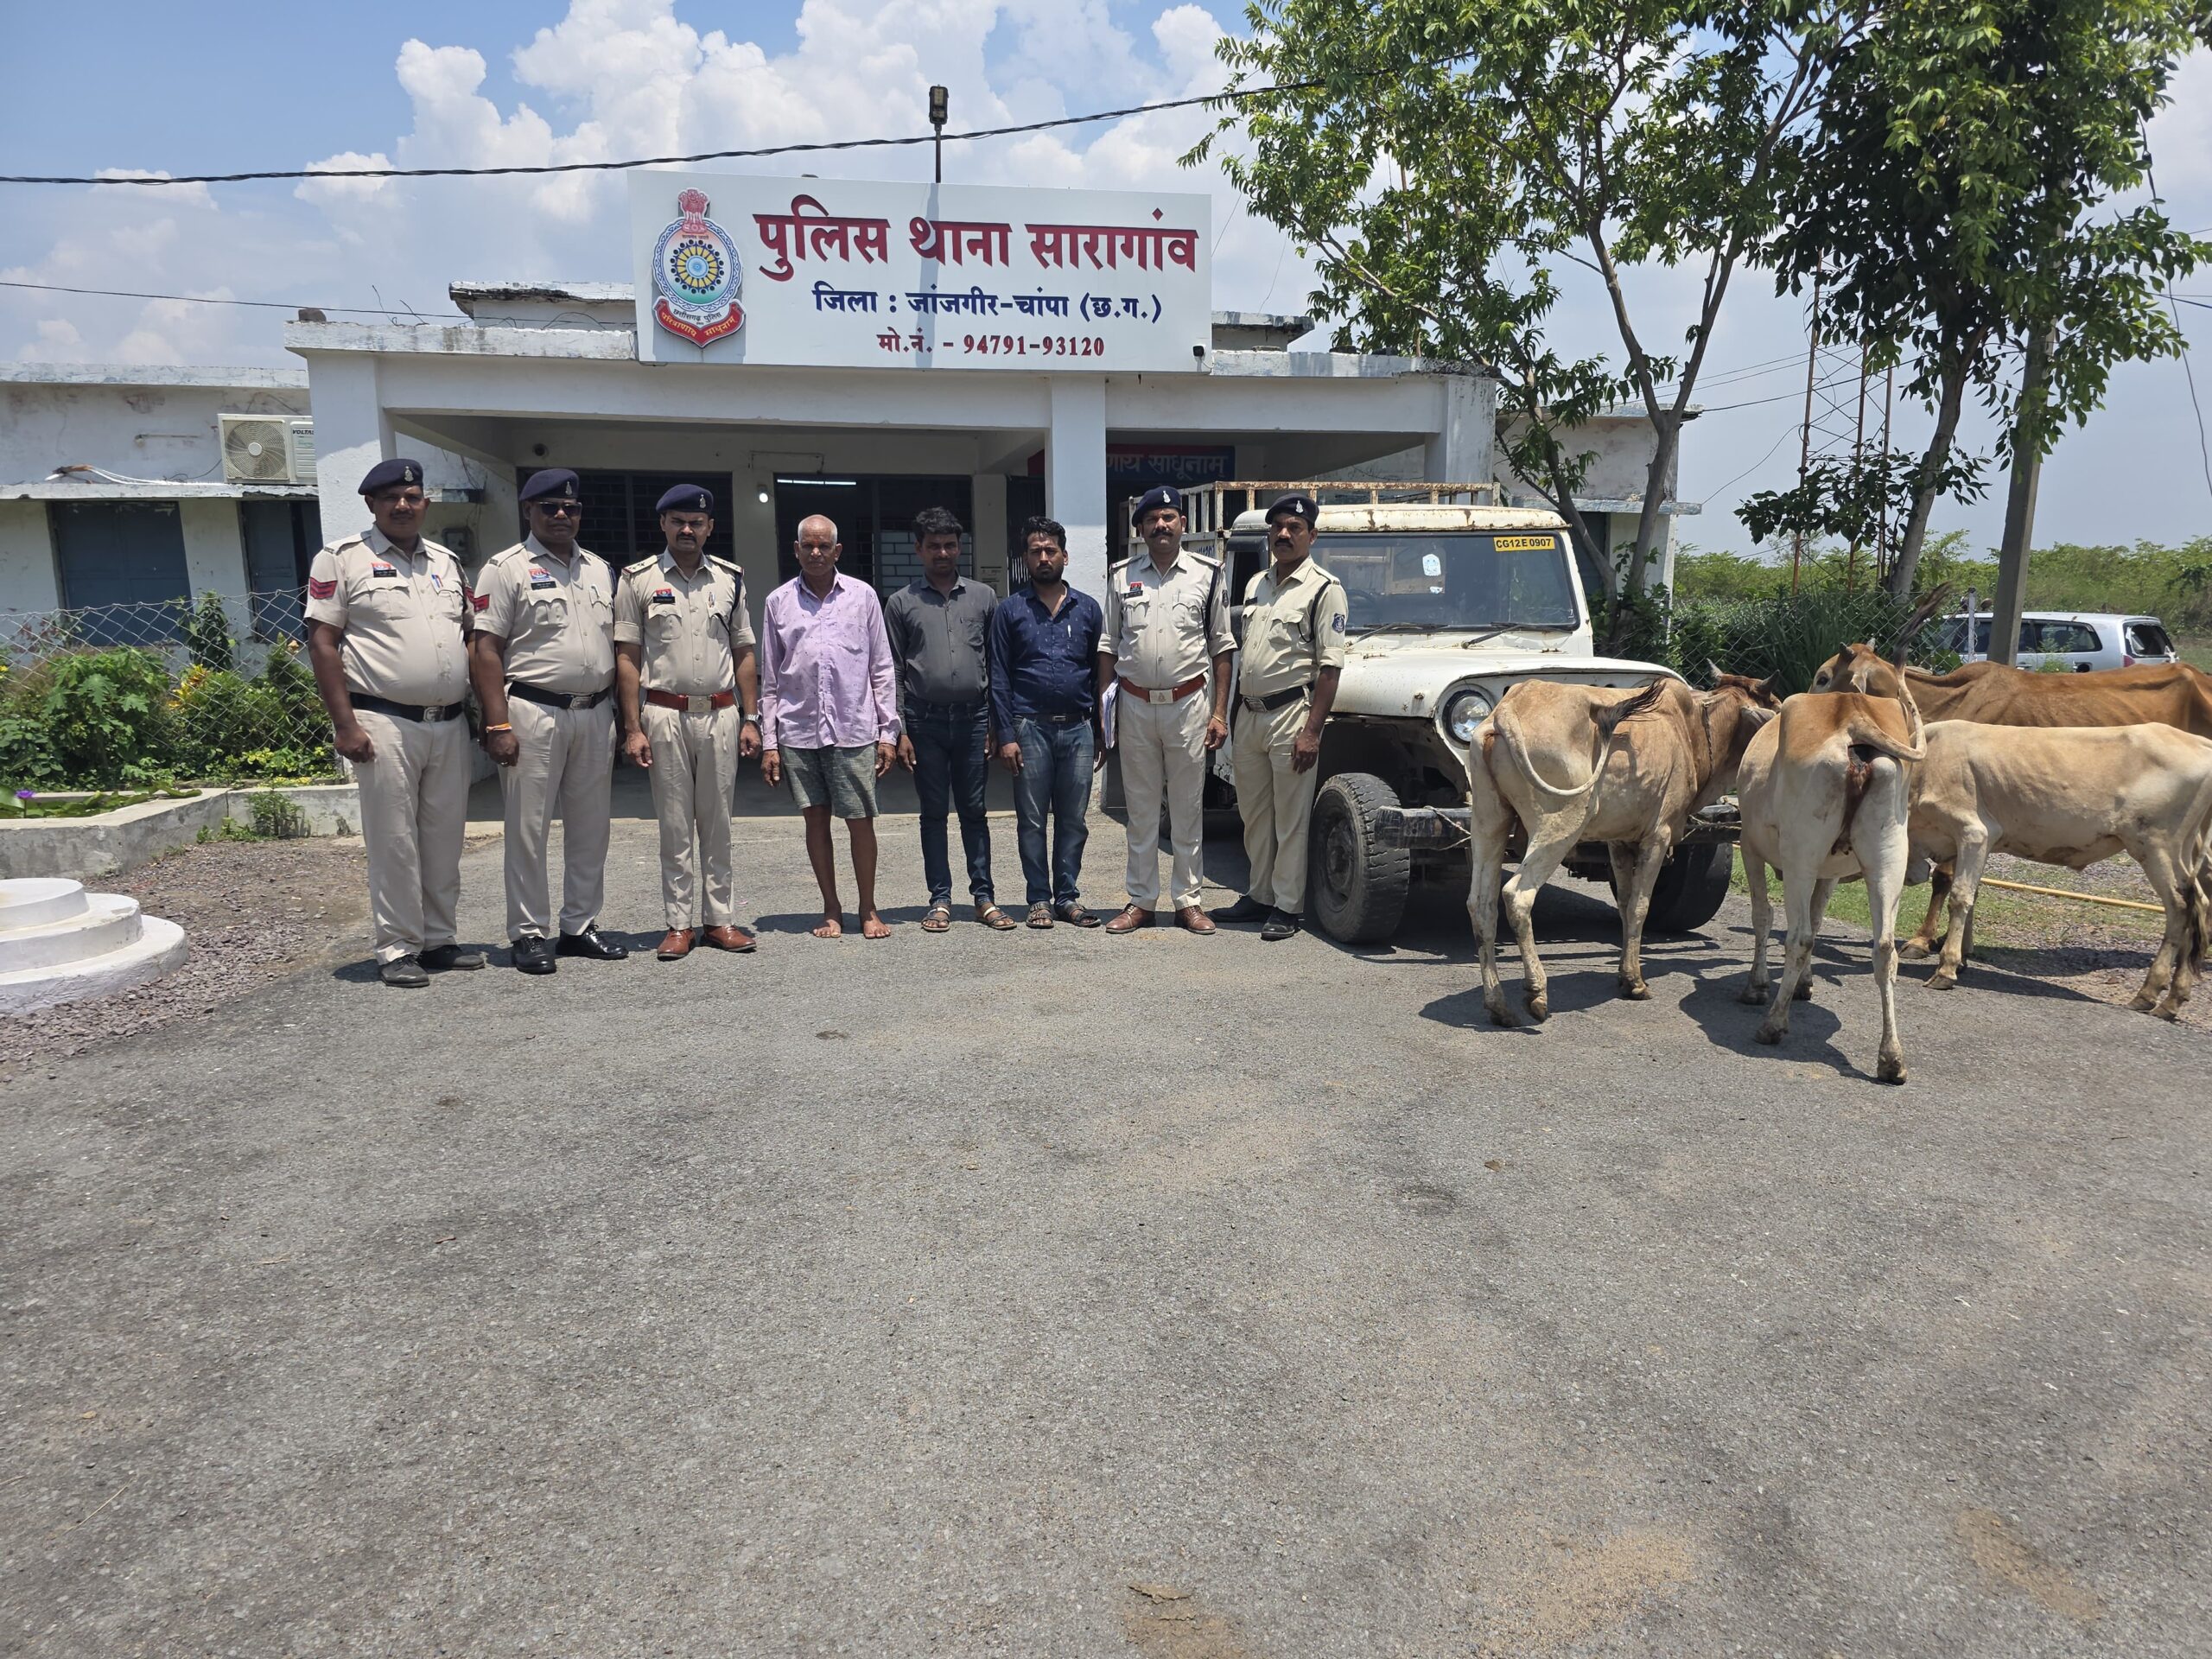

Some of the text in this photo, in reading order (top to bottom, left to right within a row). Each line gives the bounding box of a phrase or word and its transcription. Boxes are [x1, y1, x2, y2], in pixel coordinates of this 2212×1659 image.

[753, 194, 1199, 282] पुलिस थाना सारागांव
[811, 280, 879, 313] जिला
[905, 283, 1070, 317] जांजगीर-चांपा
[1079, 292, 1162, 324] (छ.ग.)
[963, 334, 1105, 357] 94791-93120
[1529, 537, 1551, 547] 0907
